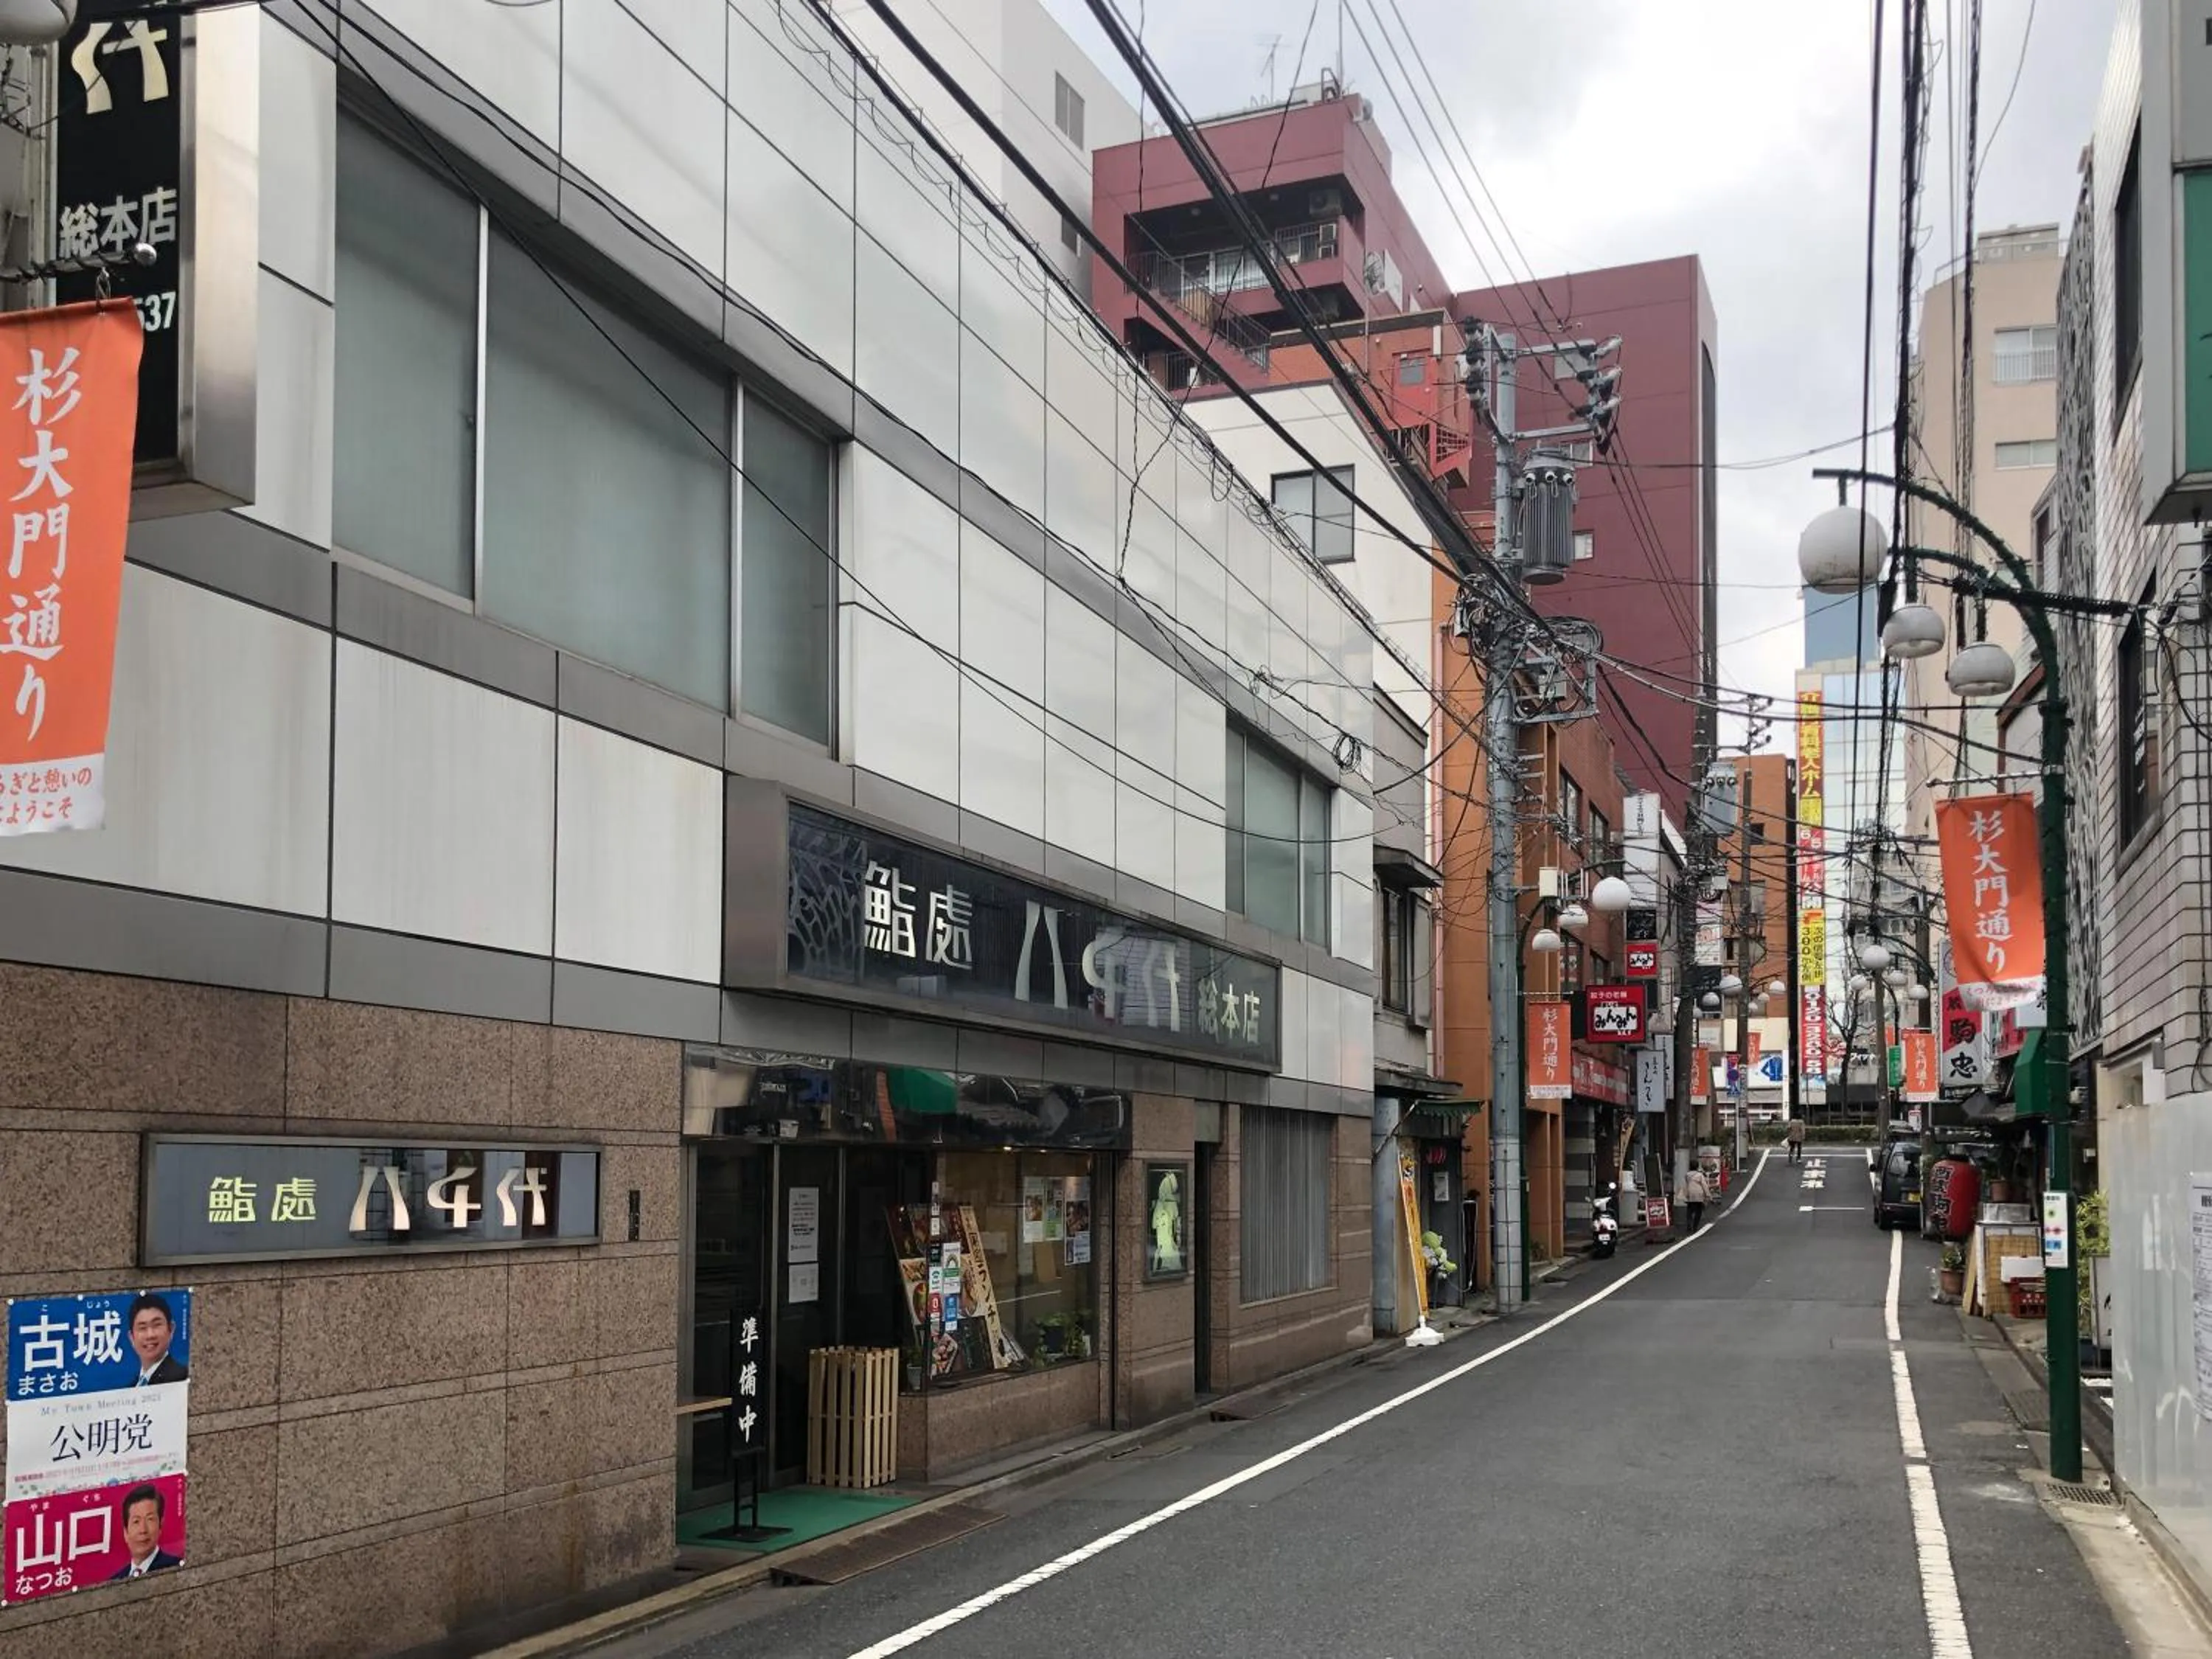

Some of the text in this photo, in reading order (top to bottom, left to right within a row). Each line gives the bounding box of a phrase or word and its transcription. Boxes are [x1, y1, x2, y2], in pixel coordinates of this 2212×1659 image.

[60, 186, 178, 260] 総本店
[0, 347, 82, 741] 杉大門通り
[0, 766, 92, 796] ぎと憩いの
[0, 796, 72, 824] ようこそ
[1969, 810, 2013, 974] 杉大門通り
[1197, 977, 1260, 1044] 総本店
[1593, 1007, 1637, 1029] みんみん
[1542, 1007, 1558, 1082] 杉大門通り
[349, 1165, 548, 1232] 八千代
[86, 1300, 111, 1310] じょう
[19, 1310, 124, 1372] 古城
[18, 1371, 79, 1396] まさお
[739, 1317, 759, 1444] 準備中
[50, 1413, 153, 1462] 公明党
[15, 1505, 112, 1573] 山口
[15, 1566, 73, 1596] なつお
